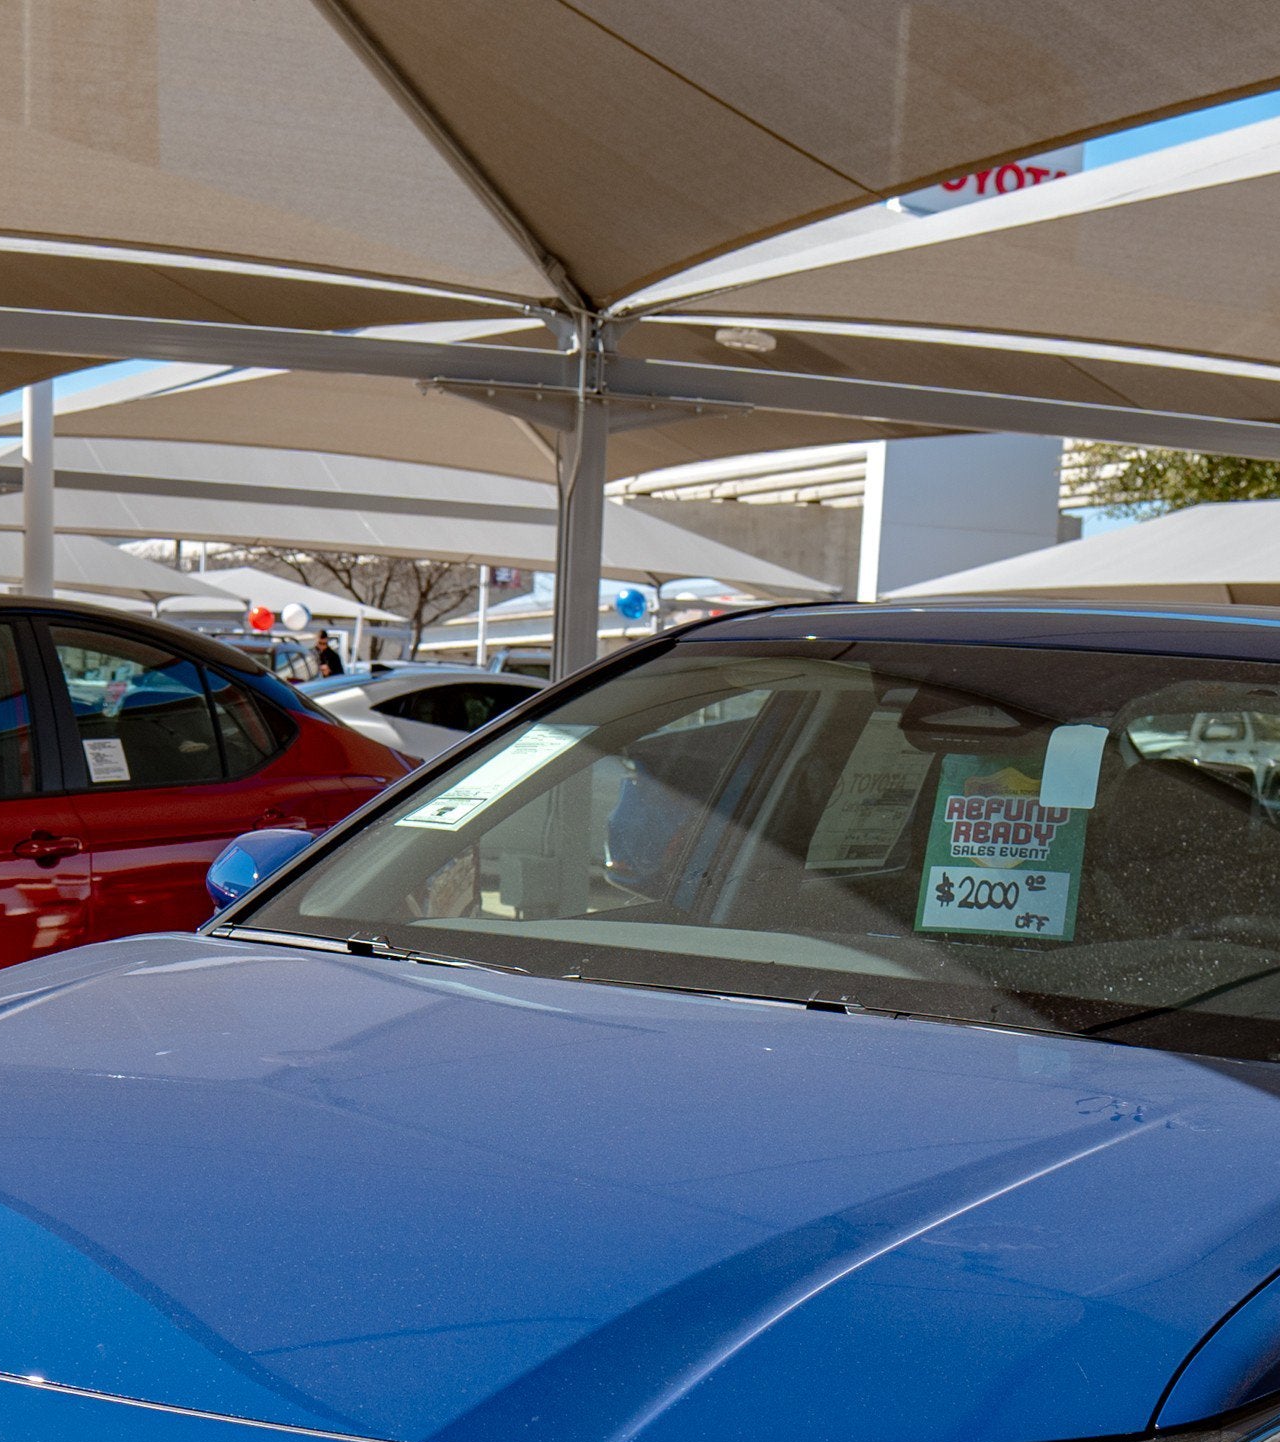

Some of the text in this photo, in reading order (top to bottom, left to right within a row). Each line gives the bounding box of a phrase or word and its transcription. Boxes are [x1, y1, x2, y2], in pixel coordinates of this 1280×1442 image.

[941, 163, 1066, 195] YOT
[946, 797, 1069, 824] REFUND
[953, 821, 1055, 846] READY
[952, 845, 1049, 860] SALES EVENT
